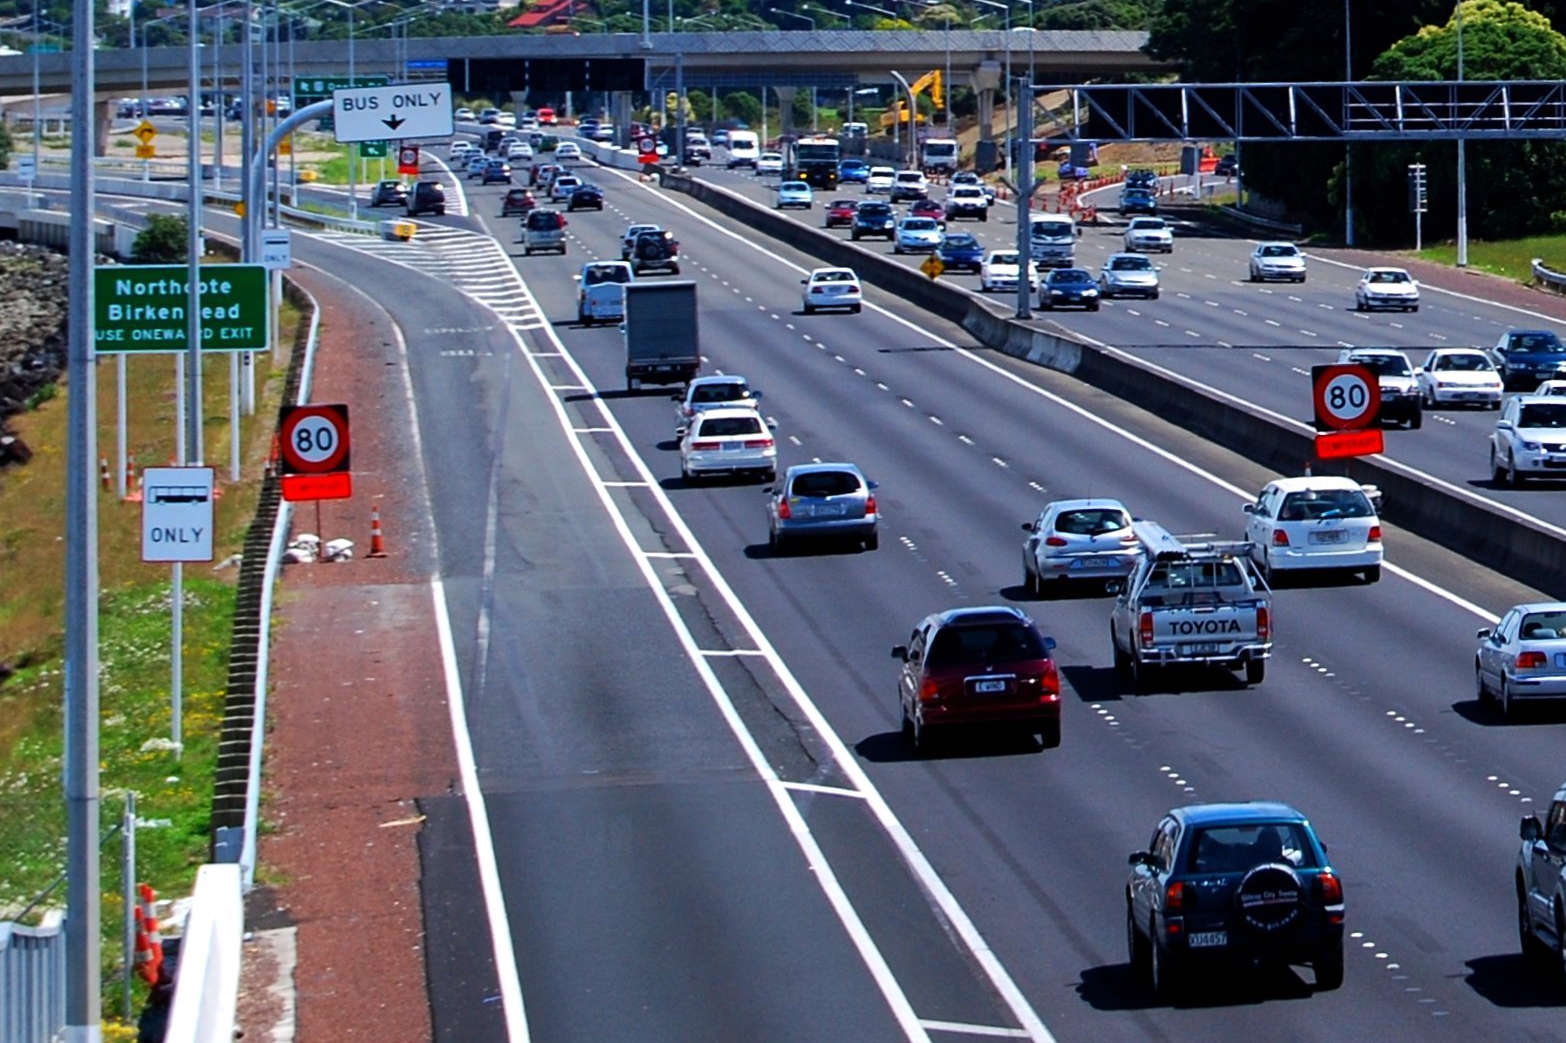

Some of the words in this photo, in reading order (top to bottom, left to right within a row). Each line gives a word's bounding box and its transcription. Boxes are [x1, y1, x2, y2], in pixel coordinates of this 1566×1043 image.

[342, 96, 379, 111] BUS
[392, 92, 441, 109] ONLY
[108, 303, 240, 321] Birkenead
[220, 327, 253, 339] EXIT
[1330, 383, 1365, 410] 80
[296, 427, 333, 453] 80
[151, 528, 203, 543] ONLY
[1169, 619, 1241, 635] TOYOTA
